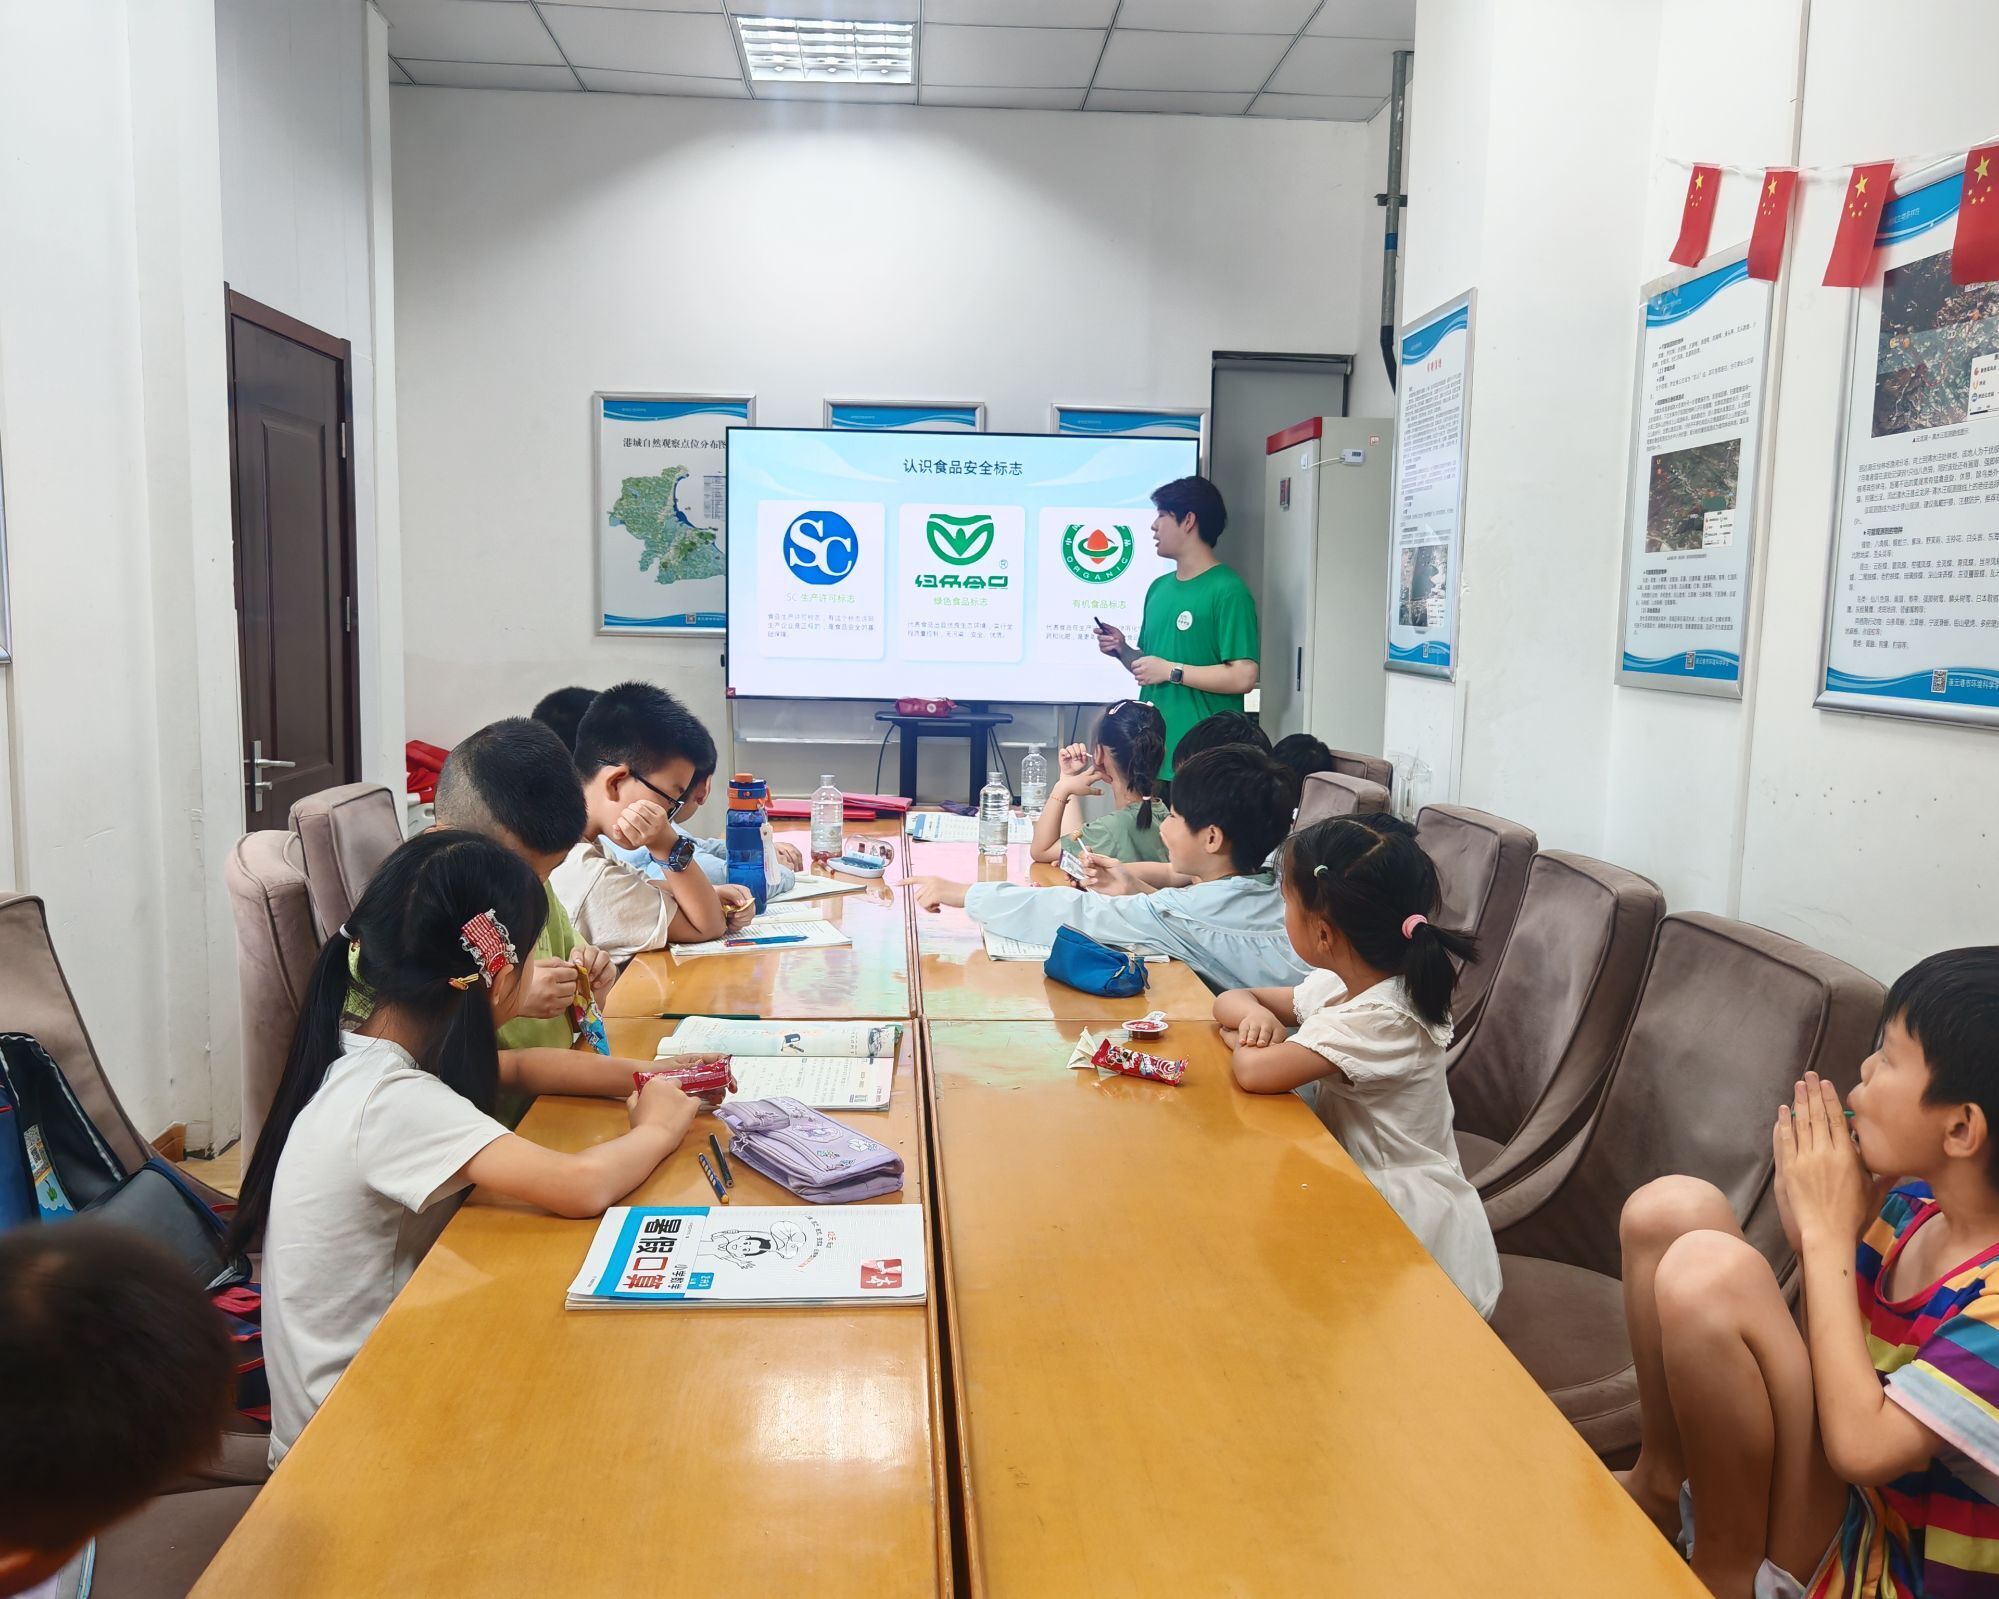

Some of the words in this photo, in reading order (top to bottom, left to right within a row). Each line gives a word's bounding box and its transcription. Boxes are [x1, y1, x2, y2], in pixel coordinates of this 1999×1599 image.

[903, 458, 1023, 476] 认识食品安全标志
[789, 518, 852, 576] SC
[1066, 556, 1128, 580] ORGANIC
[933, 597, 988, 607] 绿色食品标志
[1073, 599, 1127, 609] 有机食品标志
[623, 1219, 682, 1289] 暑假口算
